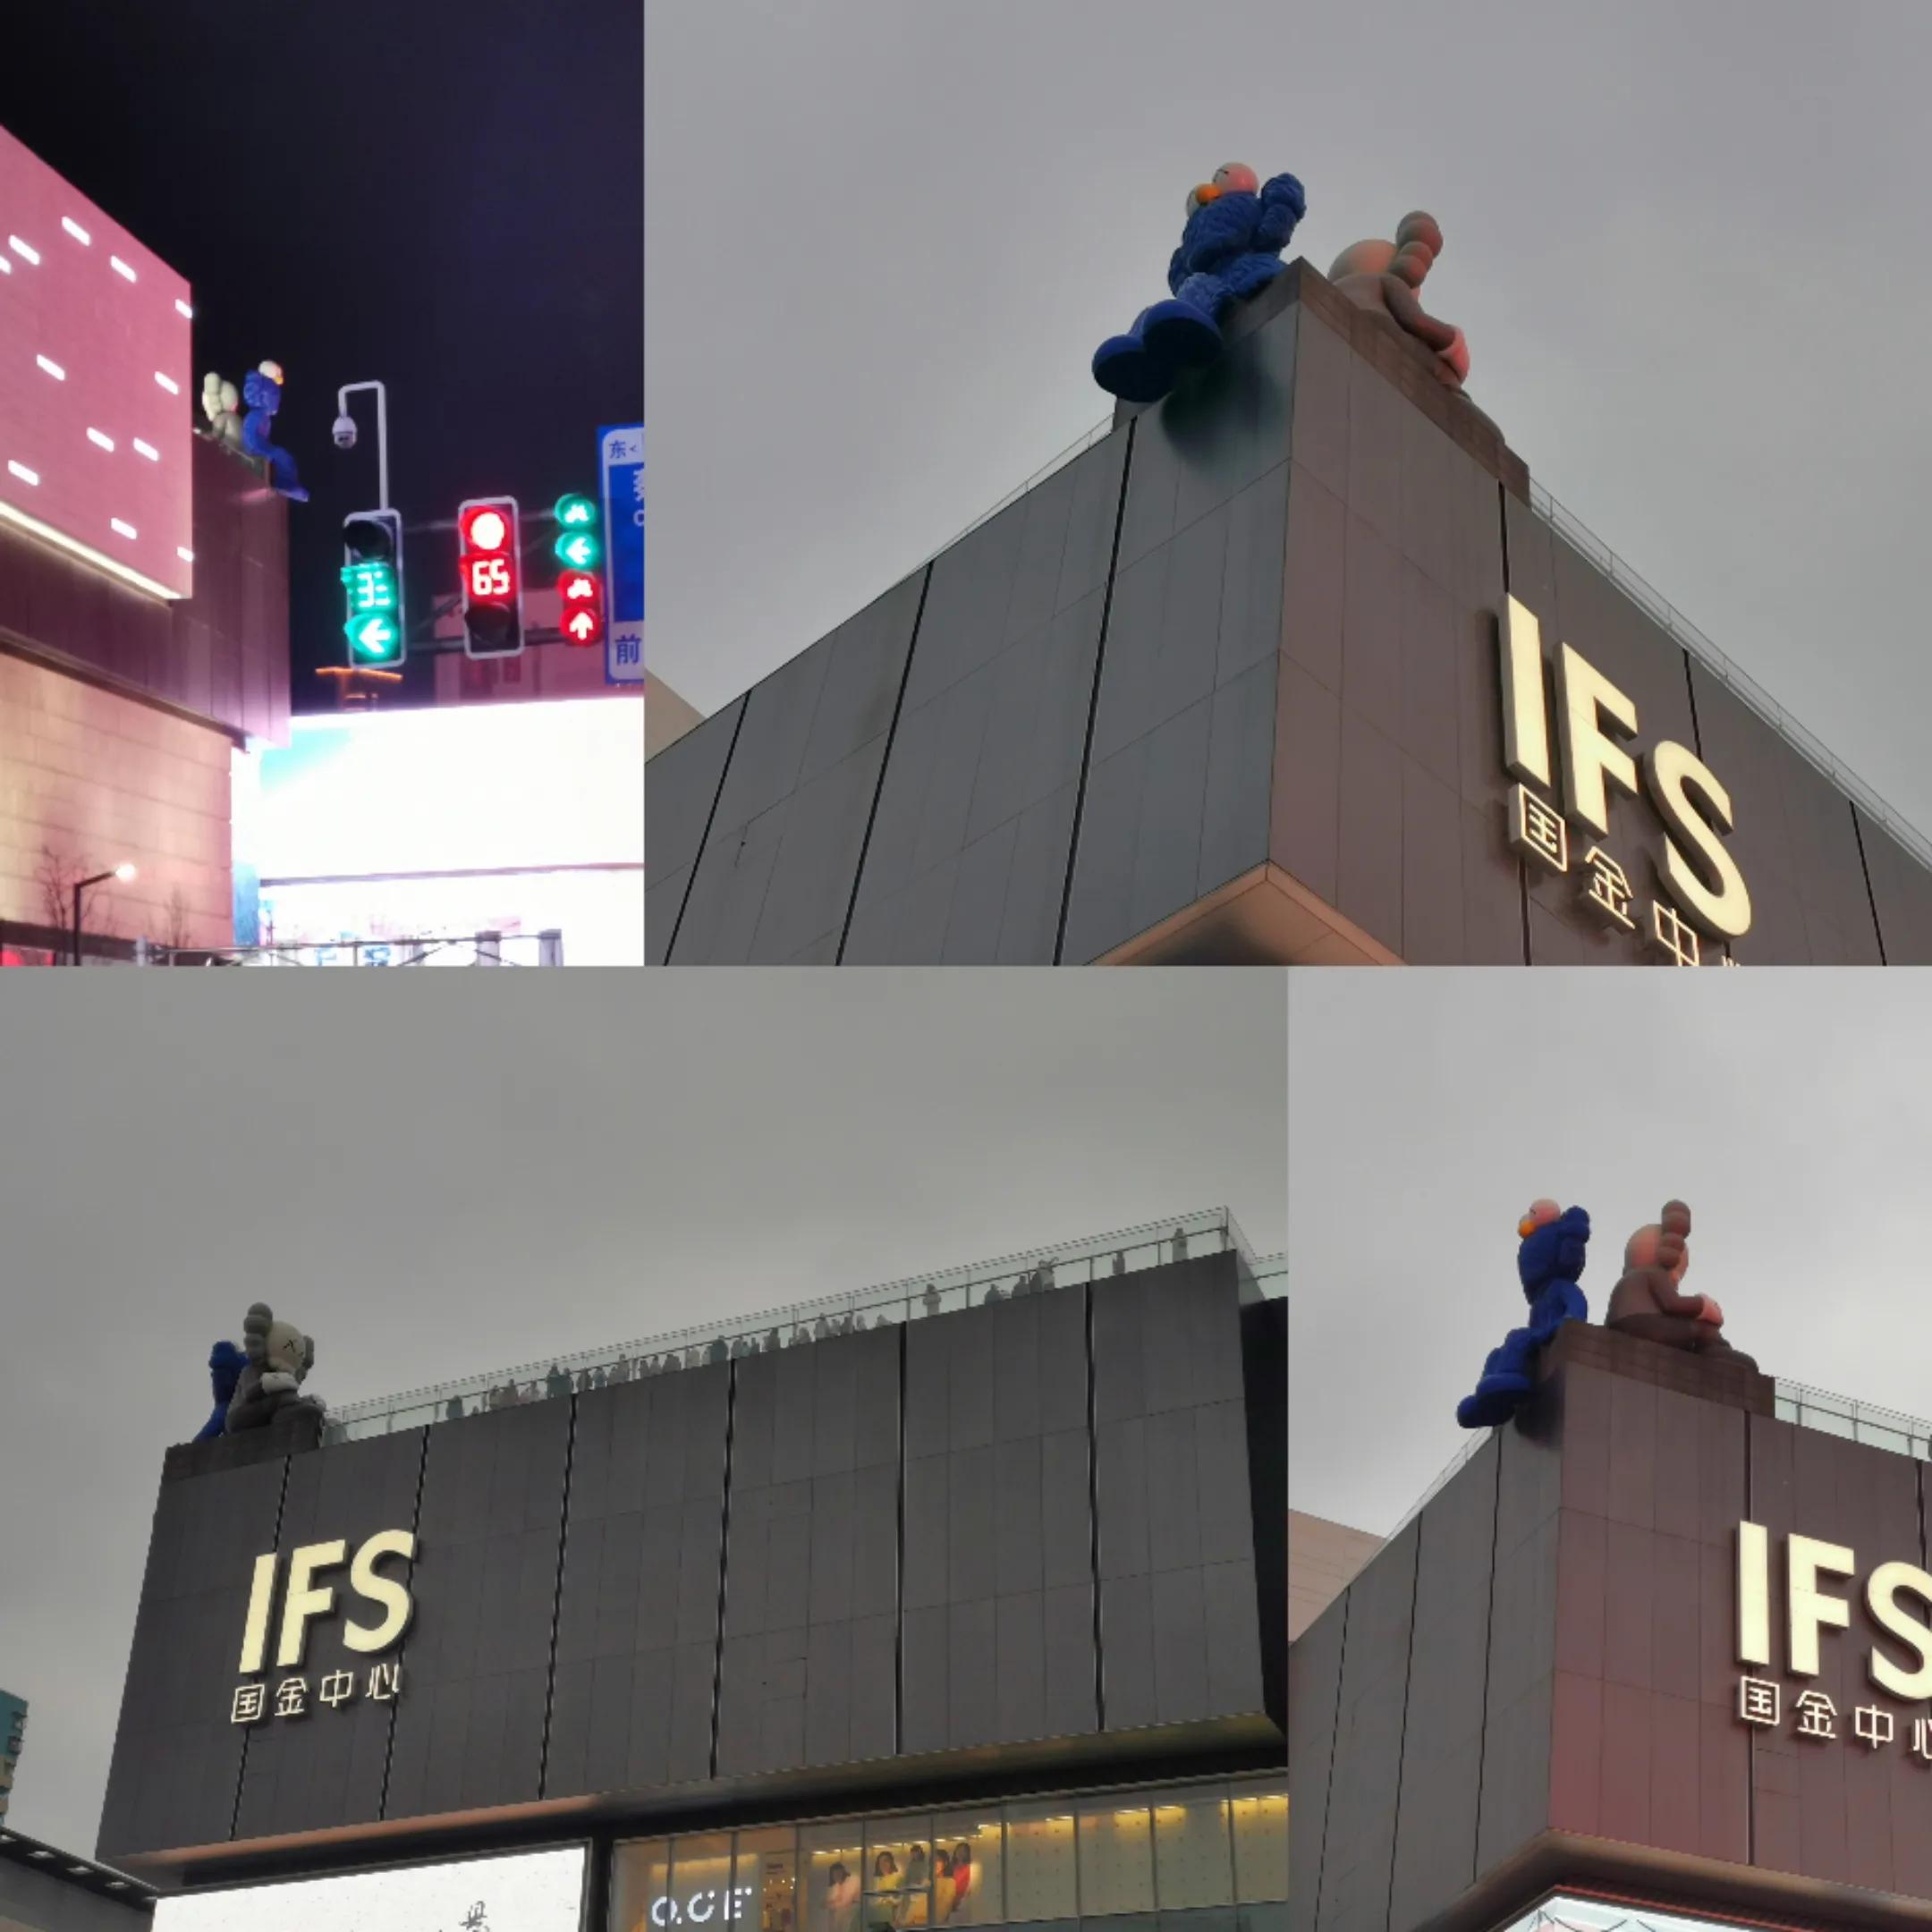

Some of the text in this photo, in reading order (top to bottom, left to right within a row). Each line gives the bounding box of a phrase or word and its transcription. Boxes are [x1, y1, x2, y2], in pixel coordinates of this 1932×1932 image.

[471, 558, 511, 596] 65
[614, 633, 642, 665] 前
[1506, 593, 1751, 936] IFS
[1518, 782, 1741, 966] 国金中
[238, 1529, 415, 1673] IFS
[1739, 1520, 1932, 1699] IFS
[230, 1662, 401, 1724] 国金中心
